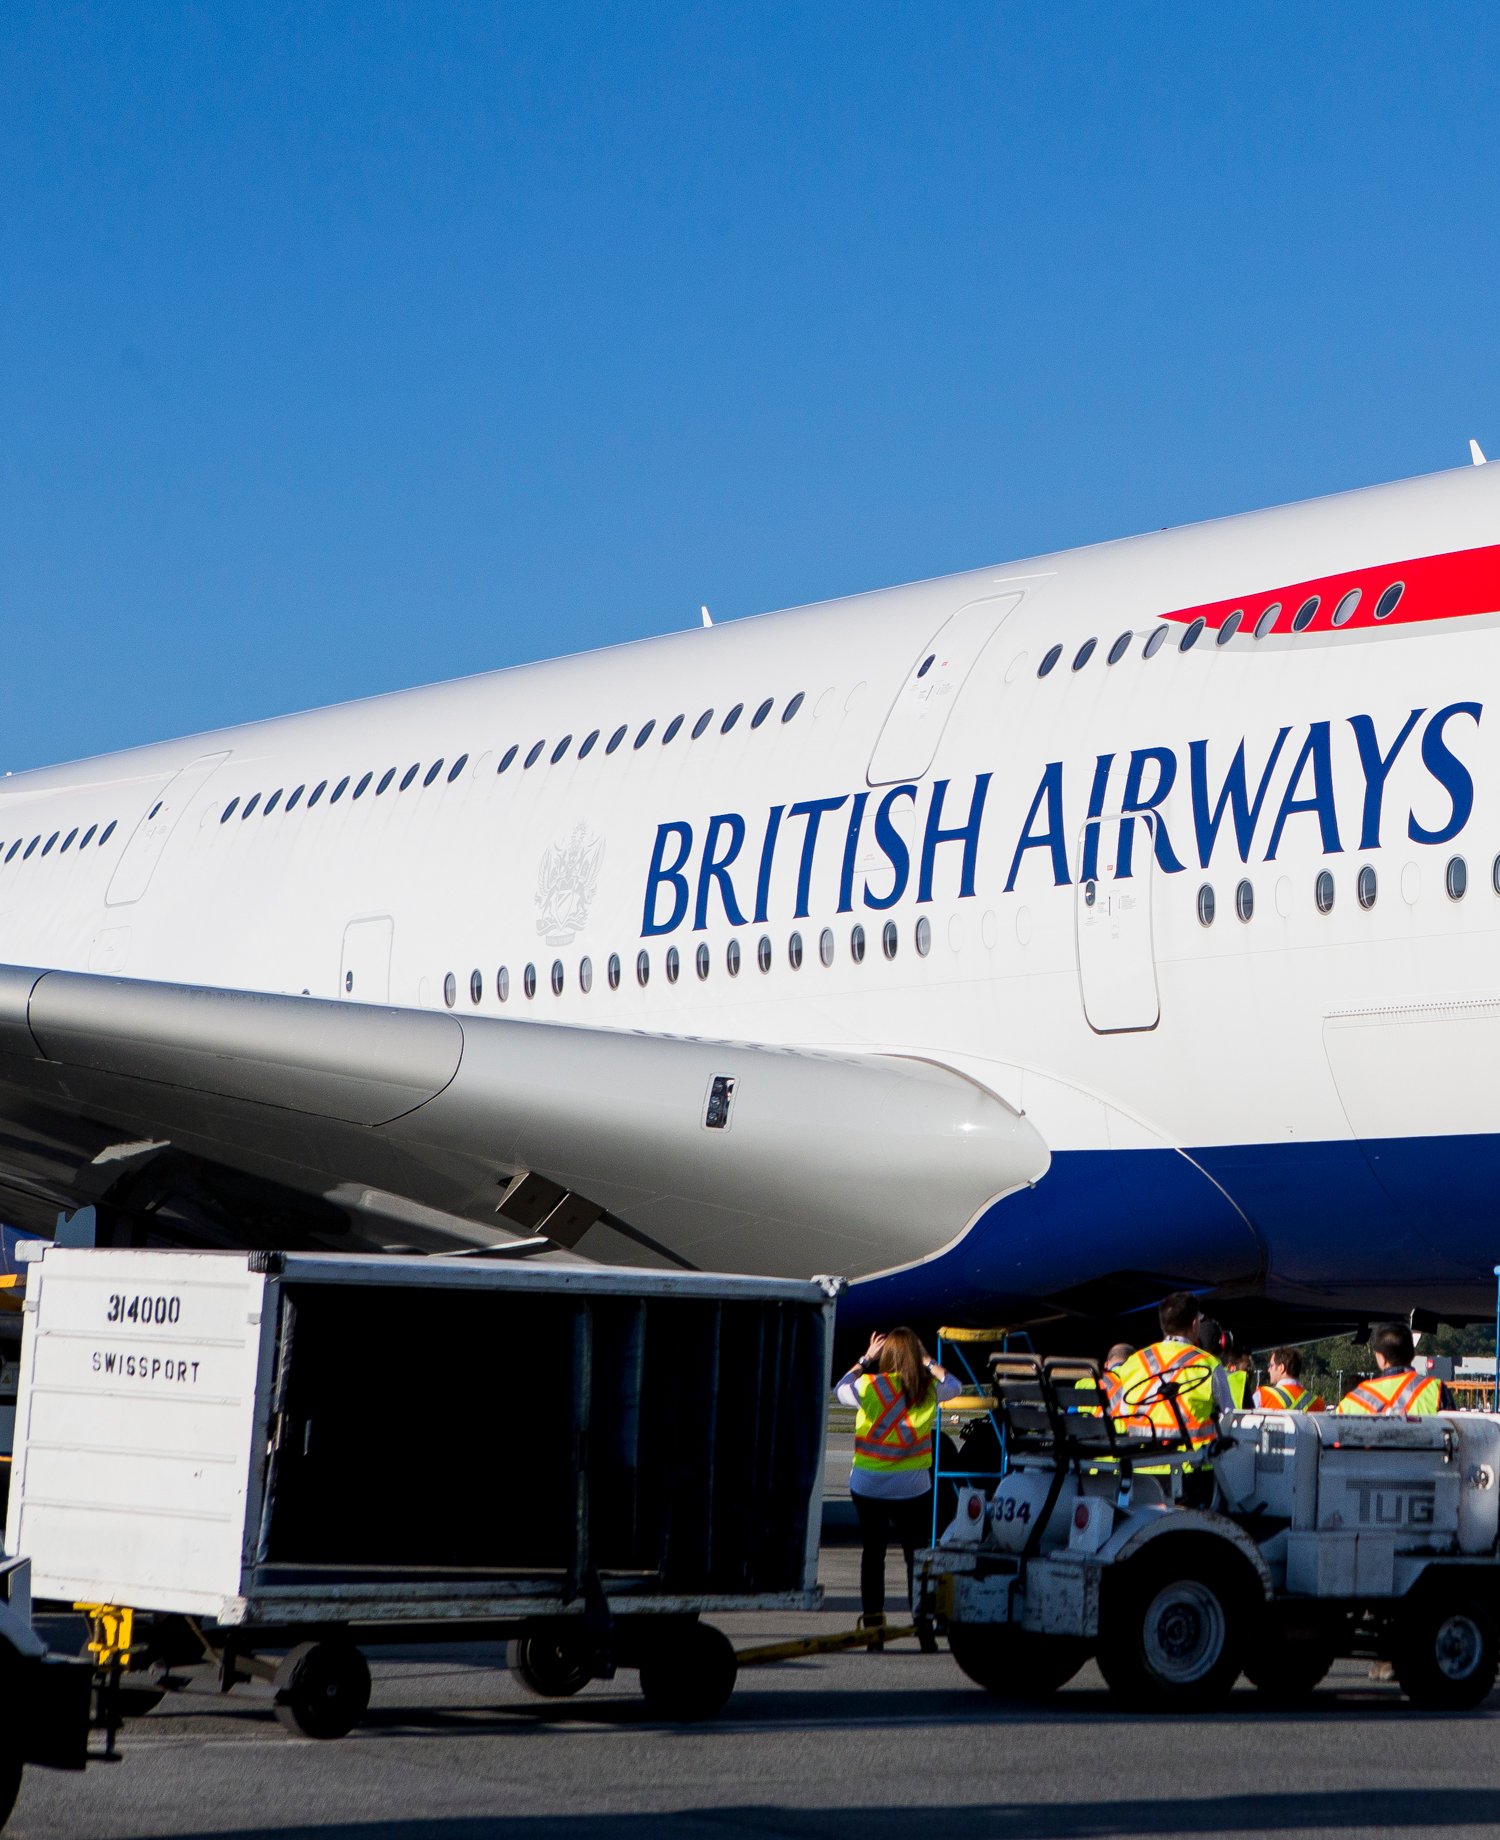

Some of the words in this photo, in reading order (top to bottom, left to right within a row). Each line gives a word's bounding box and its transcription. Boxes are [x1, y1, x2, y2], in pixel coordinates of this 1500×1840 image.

[640, 773, 992, 937] BRITISH
[1003, 701, 1483, 892] AIRWAYS
[107, 1294, 181, 1324] 314000
[92, 1351, 200, 1383] SWISSPORT
[1346, 1480, 1436, 1524] TUG
